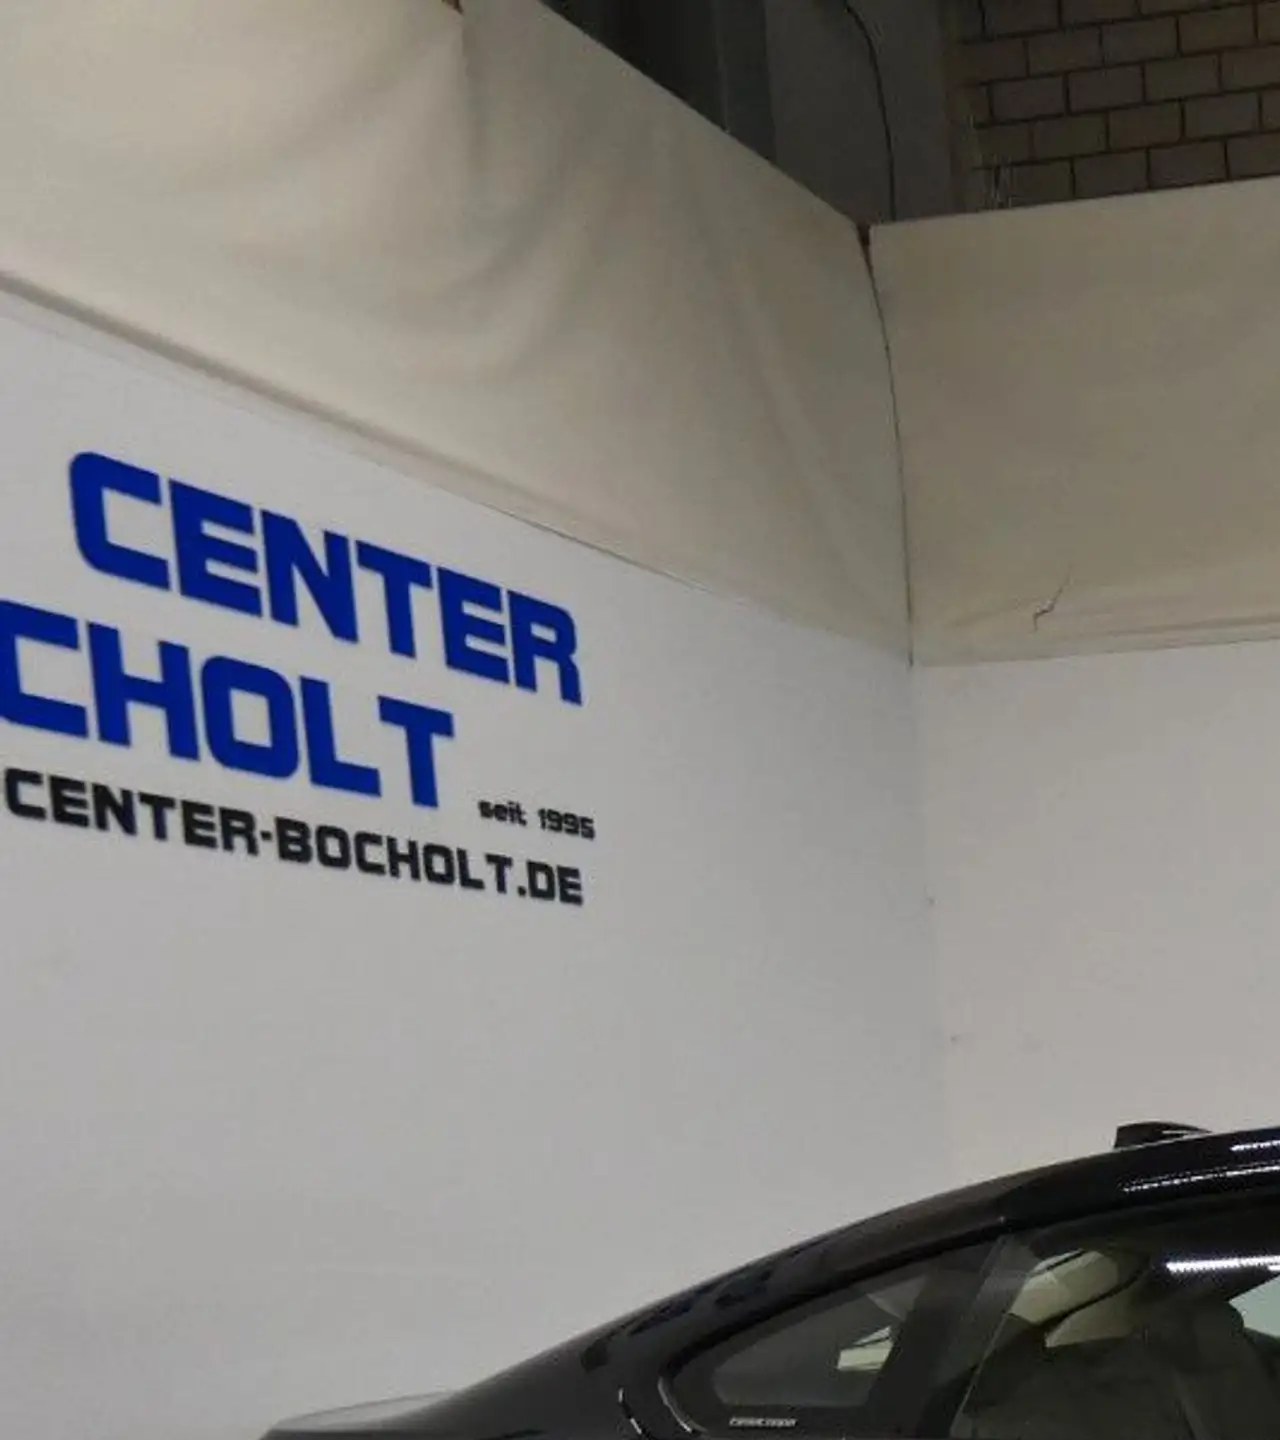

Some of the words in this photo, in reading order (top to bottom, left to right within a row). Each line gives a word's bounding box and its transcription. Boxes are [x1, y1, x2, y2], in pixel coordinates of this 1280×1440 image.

[69, 451, 582, 705] CENTER
[0, 599, 455, 809] CHOLT
[3, 766, 583, 906] CENTER-BOCHOLT.DE
[478, 799, 527, 828] seit
[537, 807, 595, 840] 1995
